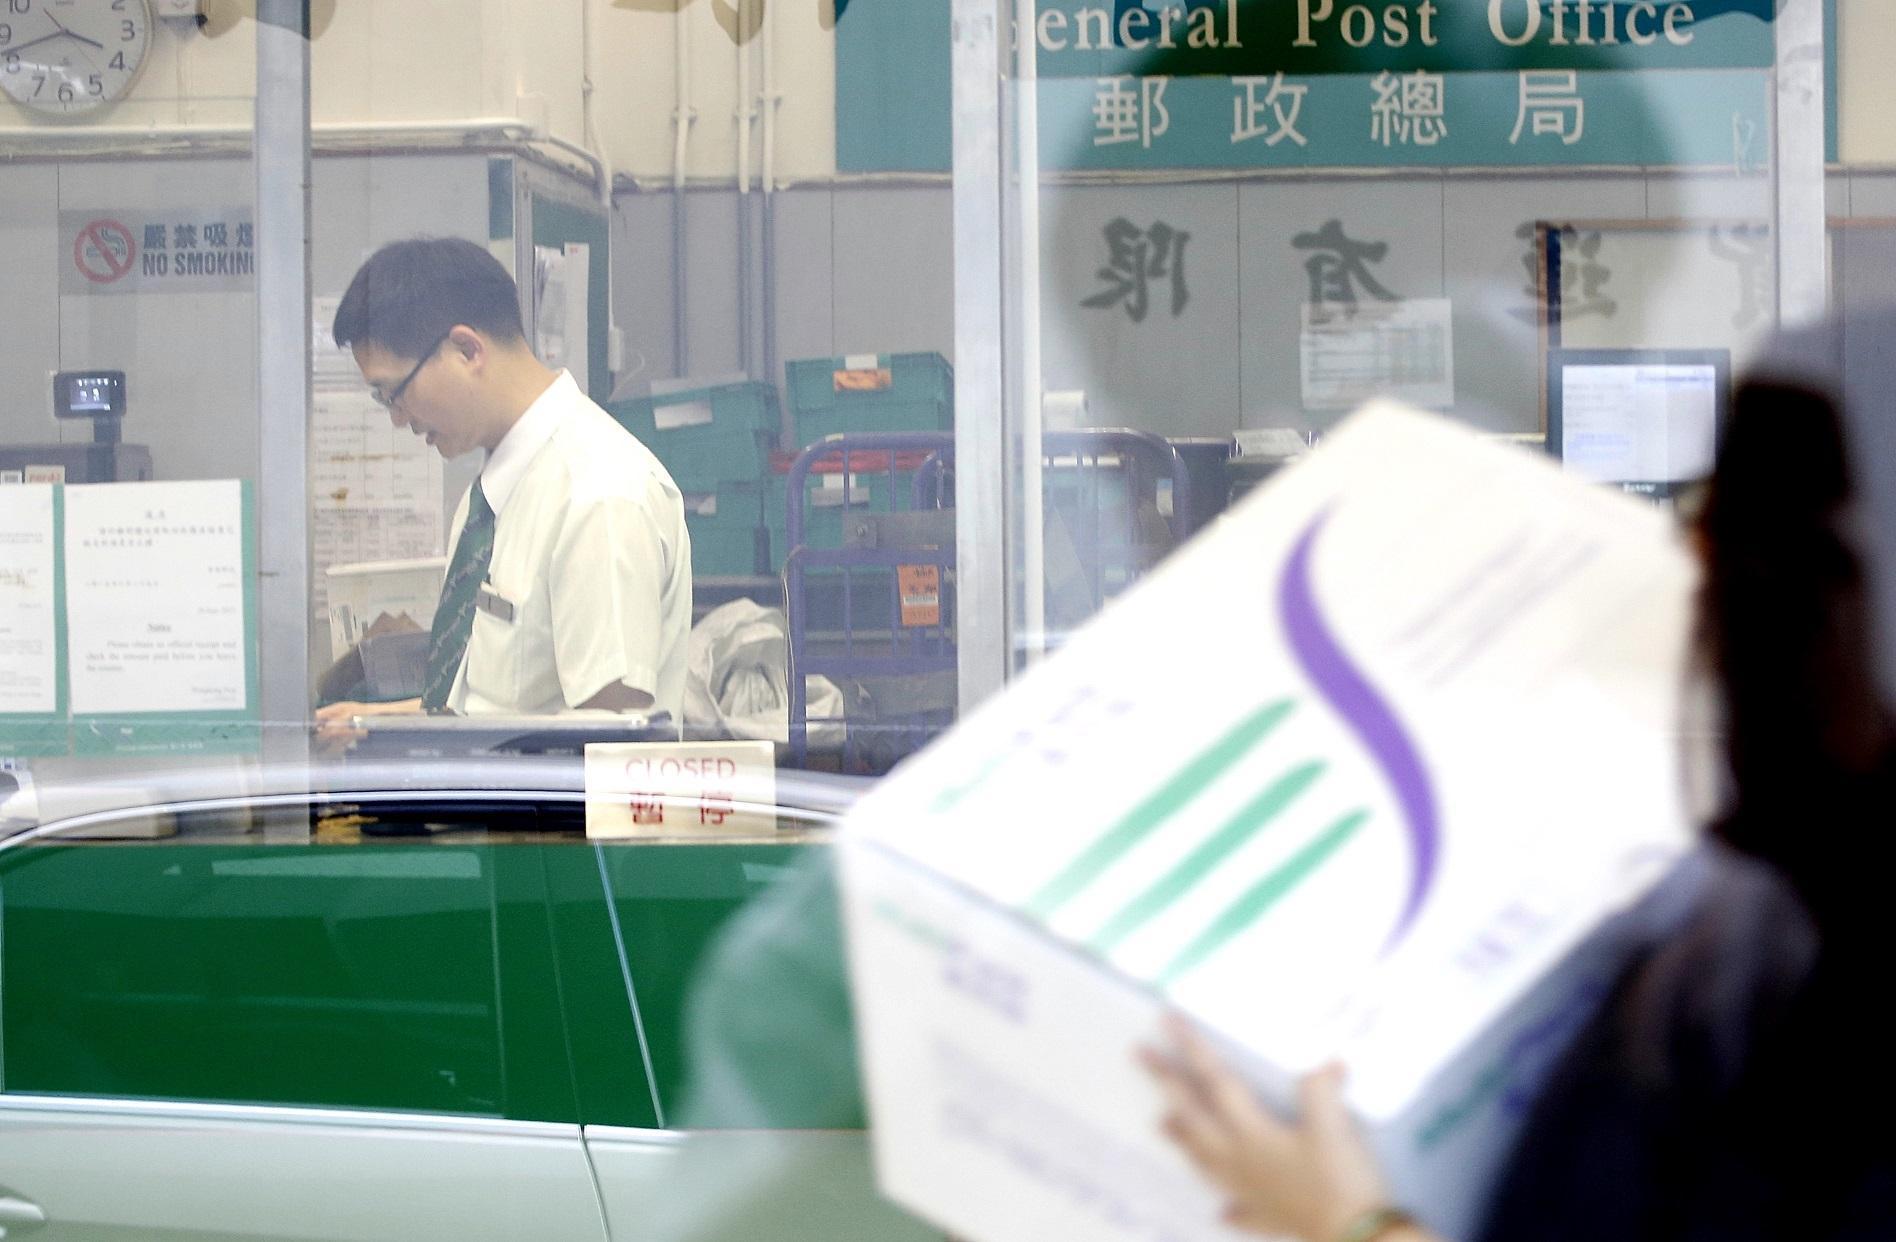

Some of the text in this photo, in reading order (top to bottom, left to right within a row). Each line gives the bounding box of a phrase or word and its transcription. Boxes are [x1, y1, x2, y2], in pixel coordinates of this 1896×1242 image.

[120, 19, 136, 42] 3
[1010, 0, 1695, 50] eneral Post Office
[108, 50, 126, 71] 4
[31, 75, 46, 97] 7
[58, 82, 74, 104] 6
[89, 73, 104, 96] 5
[1092, 68, 1585, 148] 郵政總局
[142, 252, 168, 276] NO
[625, 757, 737, 781] CLOSED
